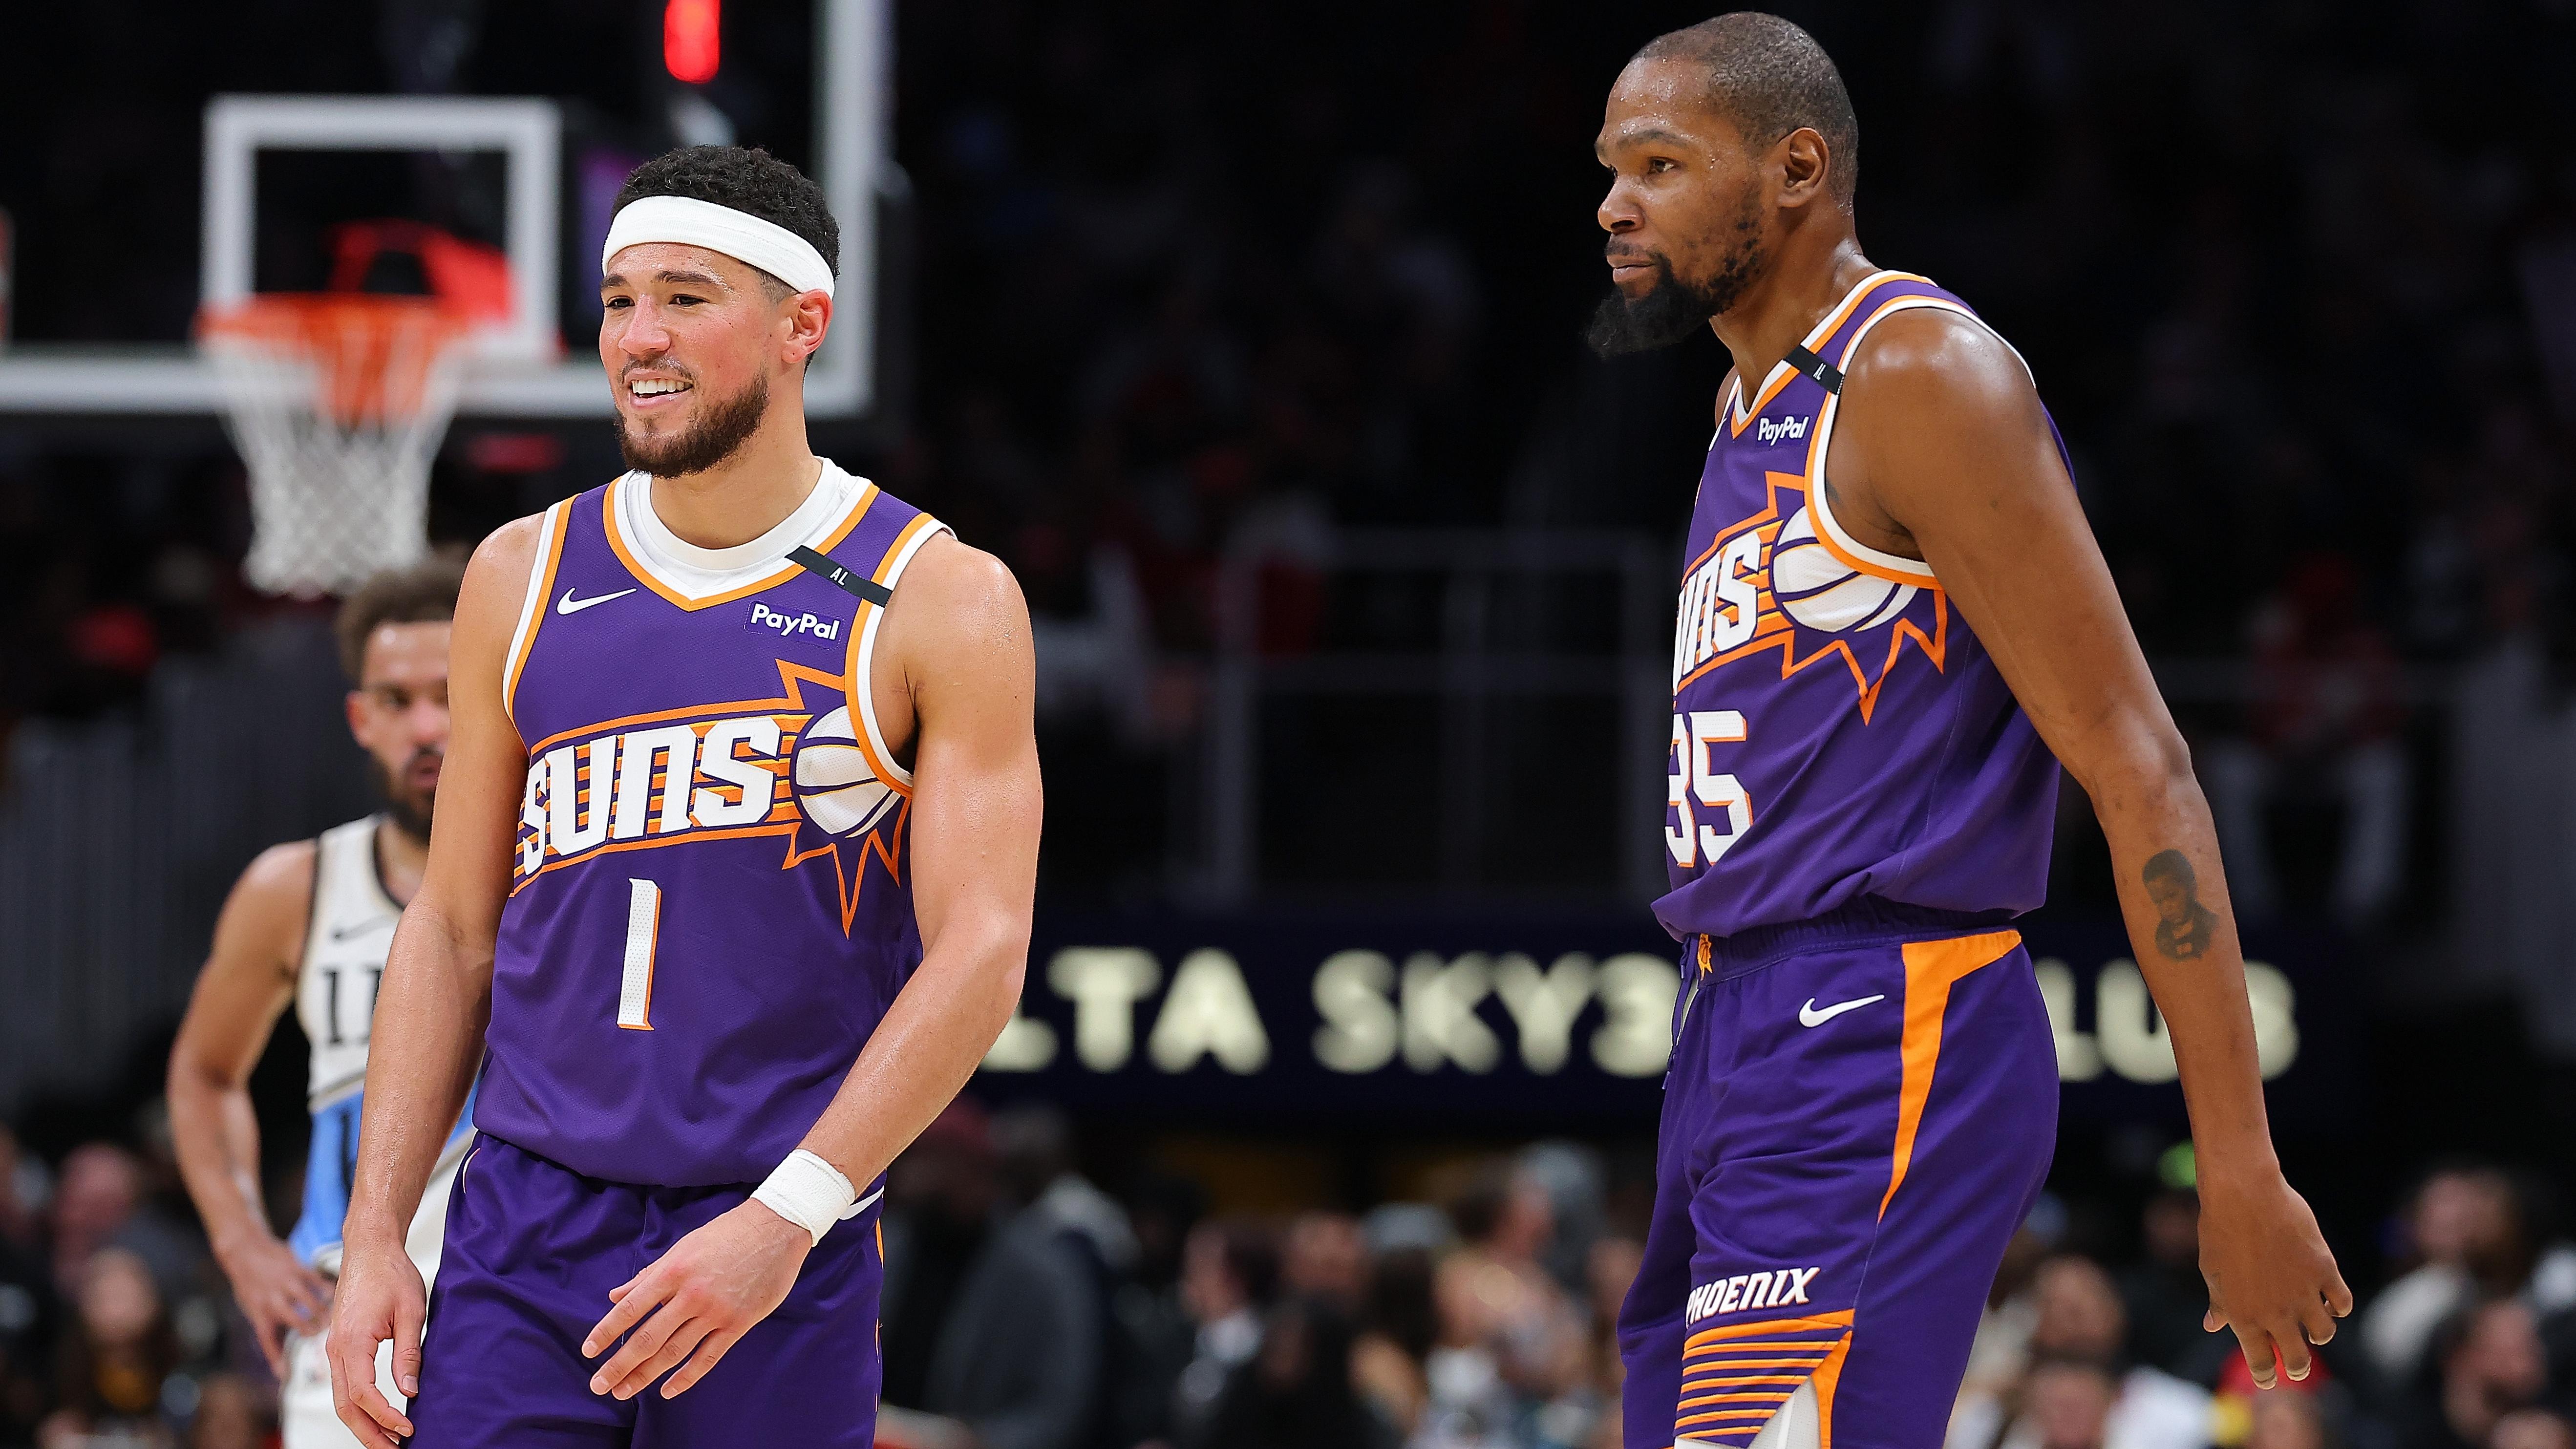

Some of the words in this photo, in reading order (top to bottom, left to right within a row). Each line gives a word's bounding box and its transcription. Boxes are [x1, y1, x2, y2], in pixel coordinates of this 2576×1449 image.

[1758, 416, 1809, 446] PayPal
[750, 603, 840, 640] PayPal
[830, 567, 849, 586] AL
[523, 717, 781, 875] SUNS
[1665, 710, 1753, 868] 35
[617, 878, 661, 1031] 1
